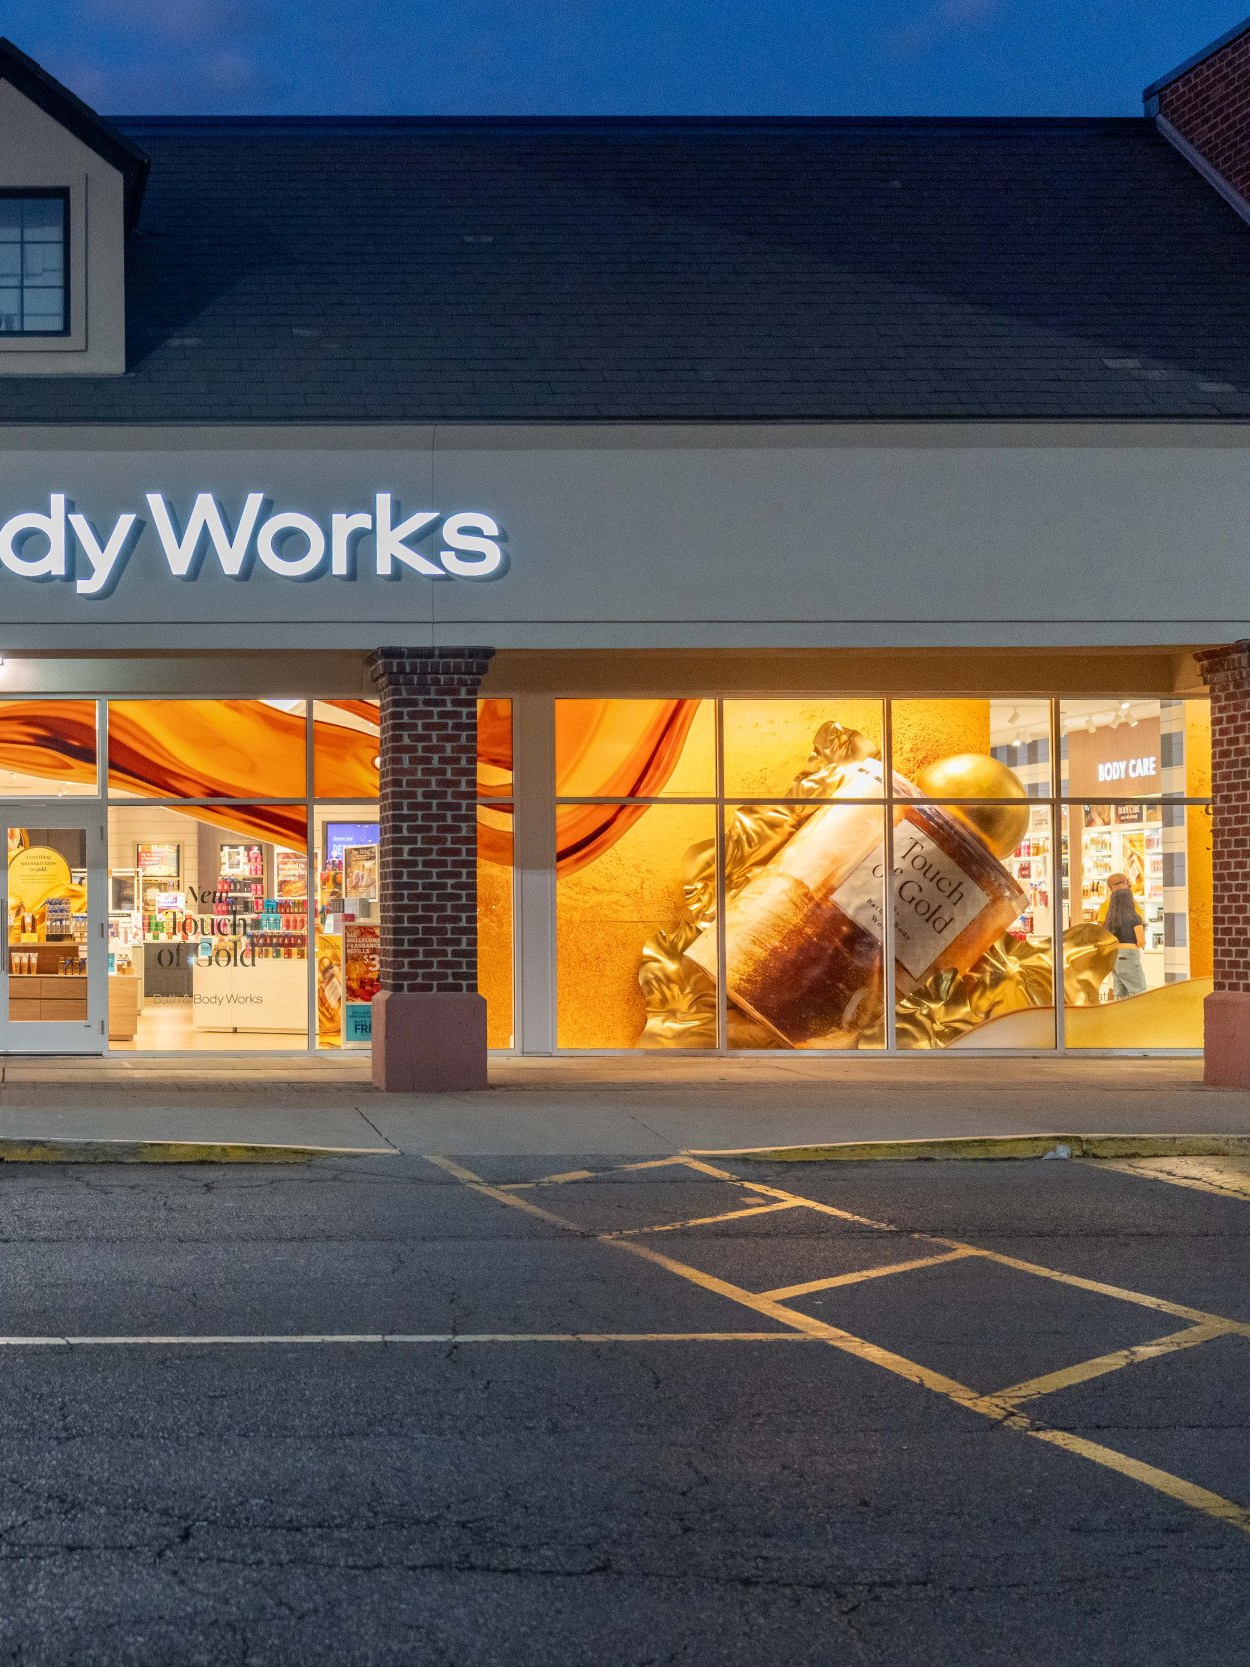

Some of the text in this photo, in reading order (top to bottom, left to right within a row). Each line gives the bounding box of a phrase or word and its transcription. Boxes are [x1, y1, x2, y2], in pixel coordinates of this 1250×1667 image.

[146, 492, 500, 578] Works
[1098, 756, 1156, 782] BODY CARE
[901, 836, 965, 907] Touch
[185, 886, 229, 904] New
[898, 880, 954, 935] Gold
[165, 910, 248, 937] Touch
[157, 940, 257, 968] of Gold
[194, 994, 224, 1006] Body
[226, 994, 263, 1004] Works
